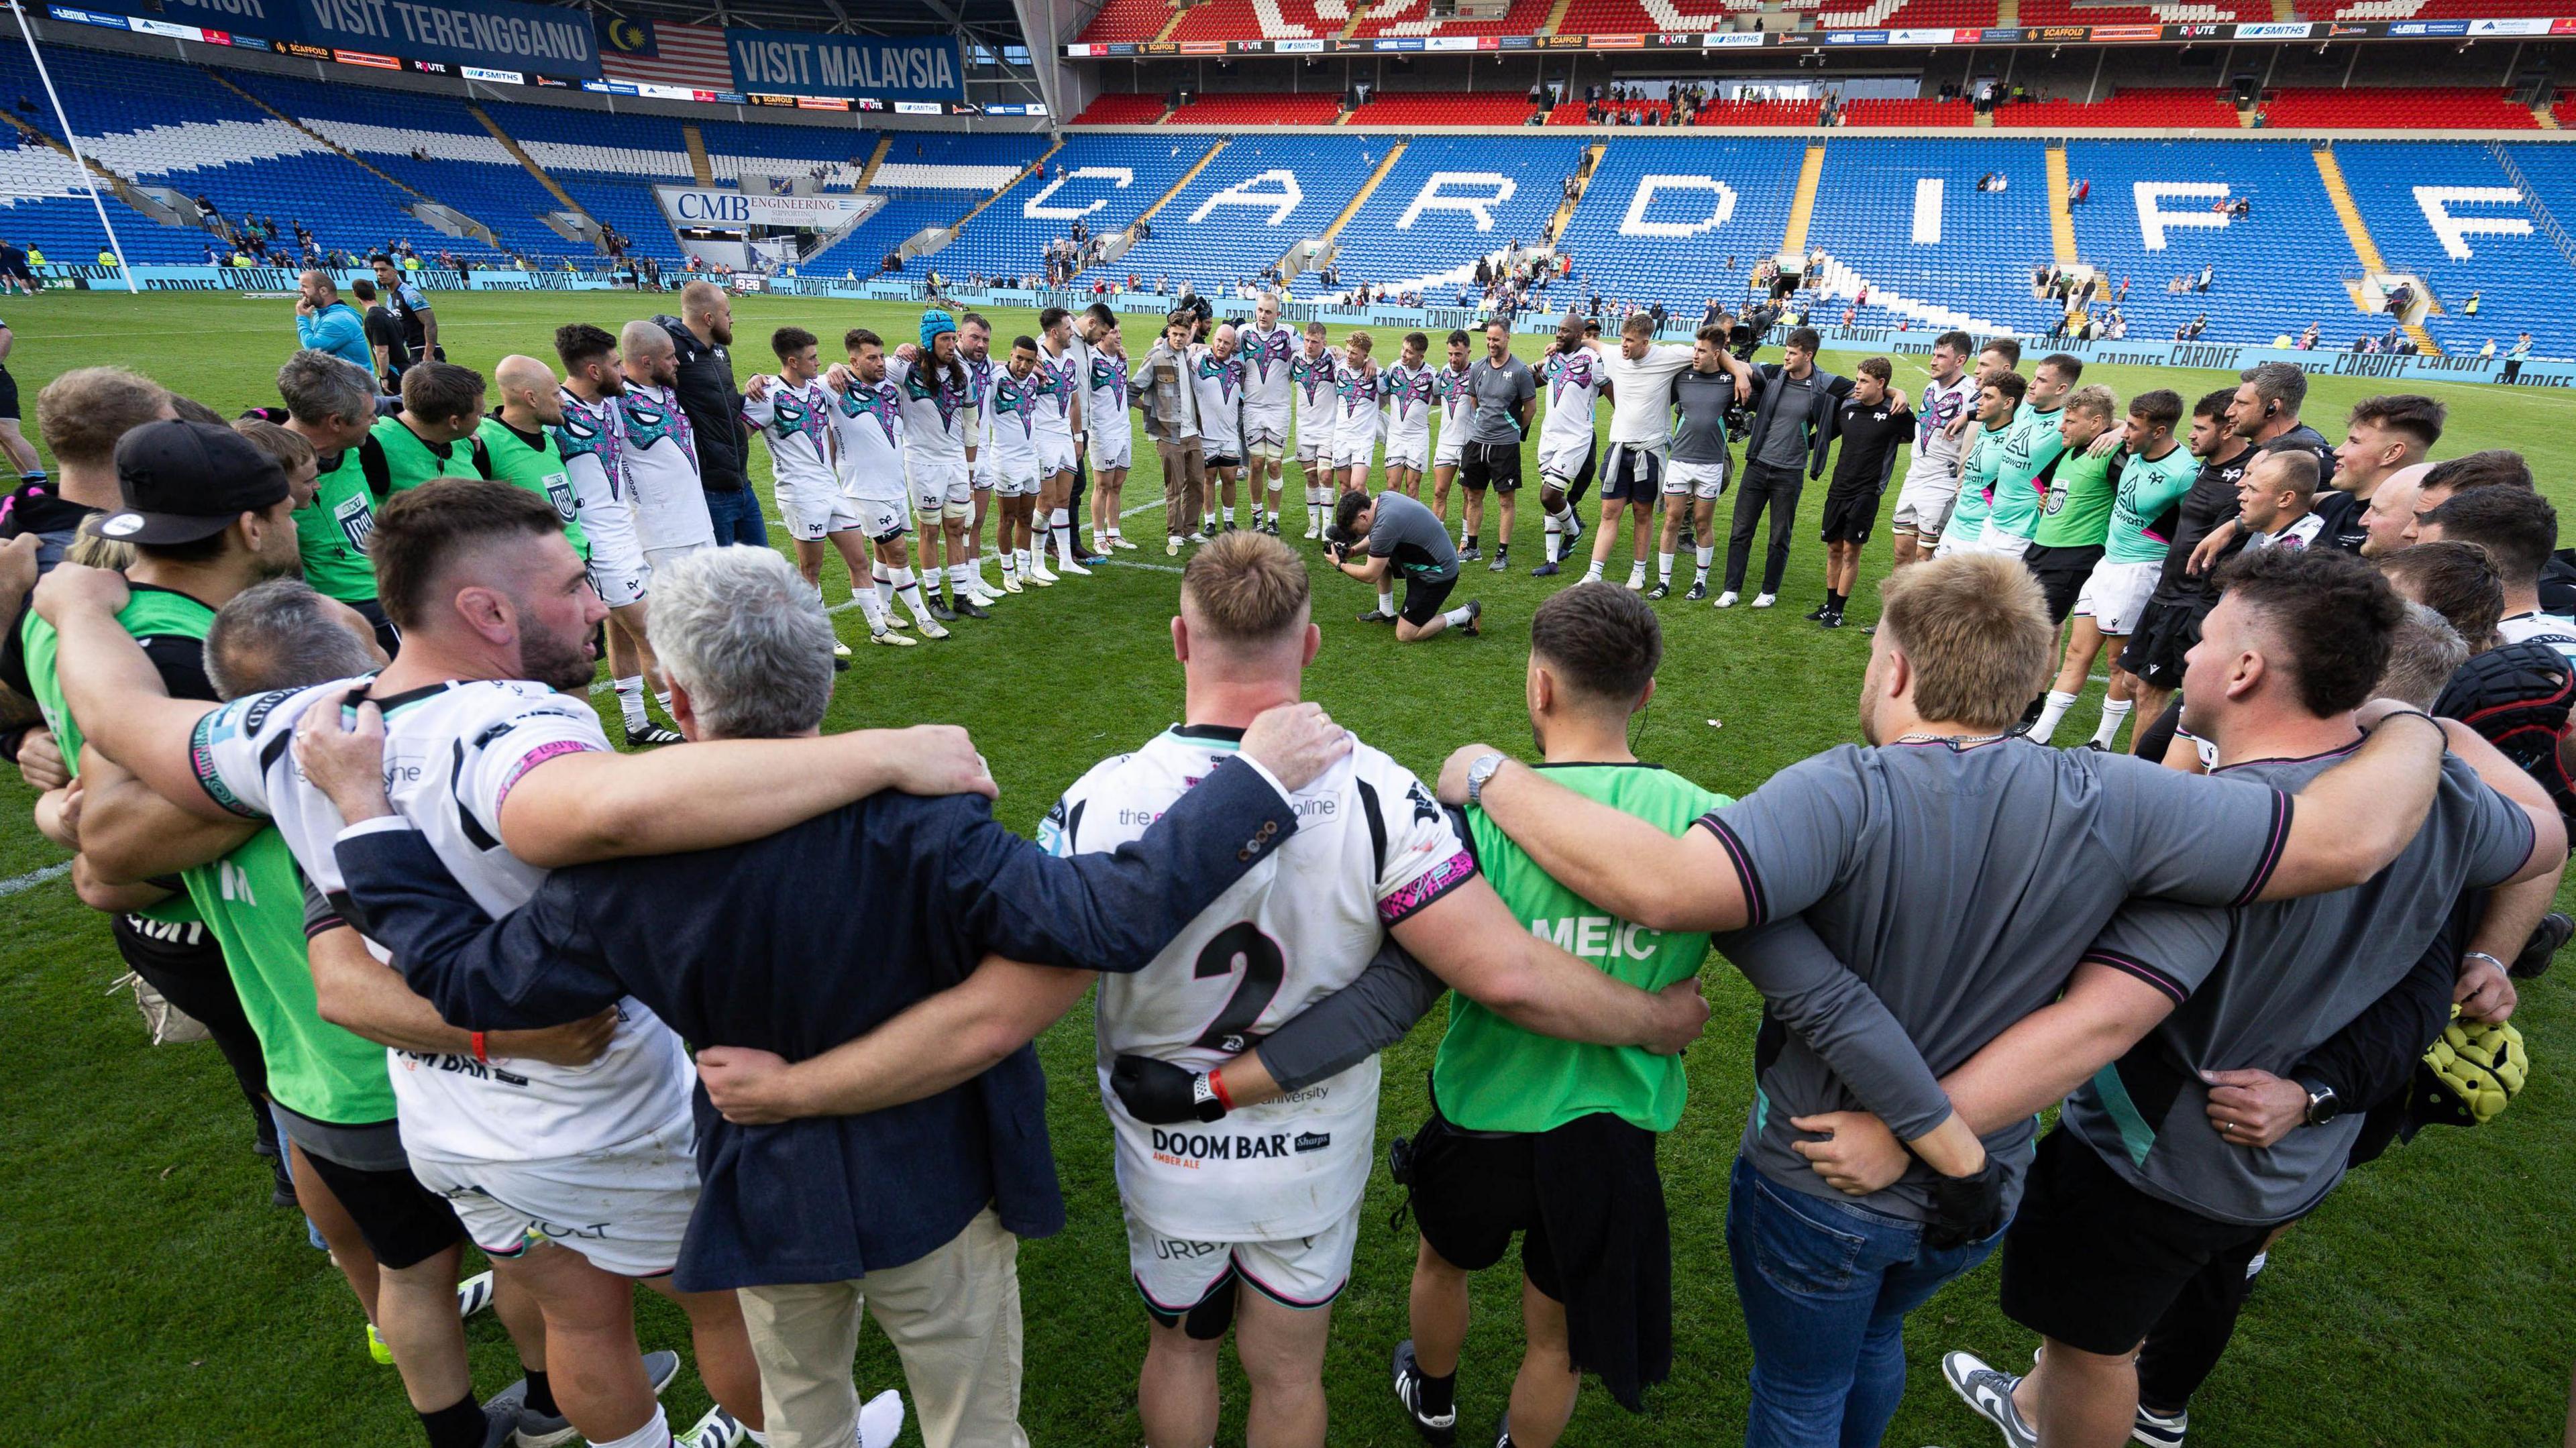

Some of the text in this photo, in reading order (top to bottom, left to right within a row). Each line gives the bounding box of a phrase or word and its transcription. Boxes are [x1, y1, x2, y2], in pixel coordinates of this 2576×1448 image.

[310, 0, 588, 62] VISIT TERENGGANU
[2043, 28, 2084, 37] SCAFFOLD
[2180, 25, 2216, 38] ROUTE
[2264, 25, 2306, 34] SMITHS
[1238, 42, 1261, 52] ROUTE
[1659, 34, 1688, 46] ROUTE
[1727, 35, 1759, 44] SMITHS
[290, 44, 328, 56] SCAFFOLD
[415, 60, 445, 74] ROUTE
[737, 39, 955, 89] VISIT MALAYSIA
[486, 71, 519, 81] SMITHS
[763, 95, 793, 105] SCAFFOLD
[860, 101, 883, 111] ROUTE
[678, 192, 750, 221] CMB
[751, 197, 835, 211] ENGINEERING
[771, 210, 813, 218] SUPPORTING
[218, 268, 287, 290] CARDIFF
[529, 272, 574, 290] CARDIFF
[735, 279, 760, 291] 1928
[794, 280, 829, 296] CARDIFF
[1035, 291, 1076, 309] CARDIFF
[1426, 310, 1476, 330] CARDIFF
[2169, 345, 2243, 369] CARDIFF
[2333, 353, 2413, 378] CARDIFF
[1119, 808, 1150, 826] the
[1191, 920, 1286, 1054] 2
[1152, 1127, 1289, 1160] DOOM BAR
[1152, 1151, 1200, 1170] AMBER ALE
